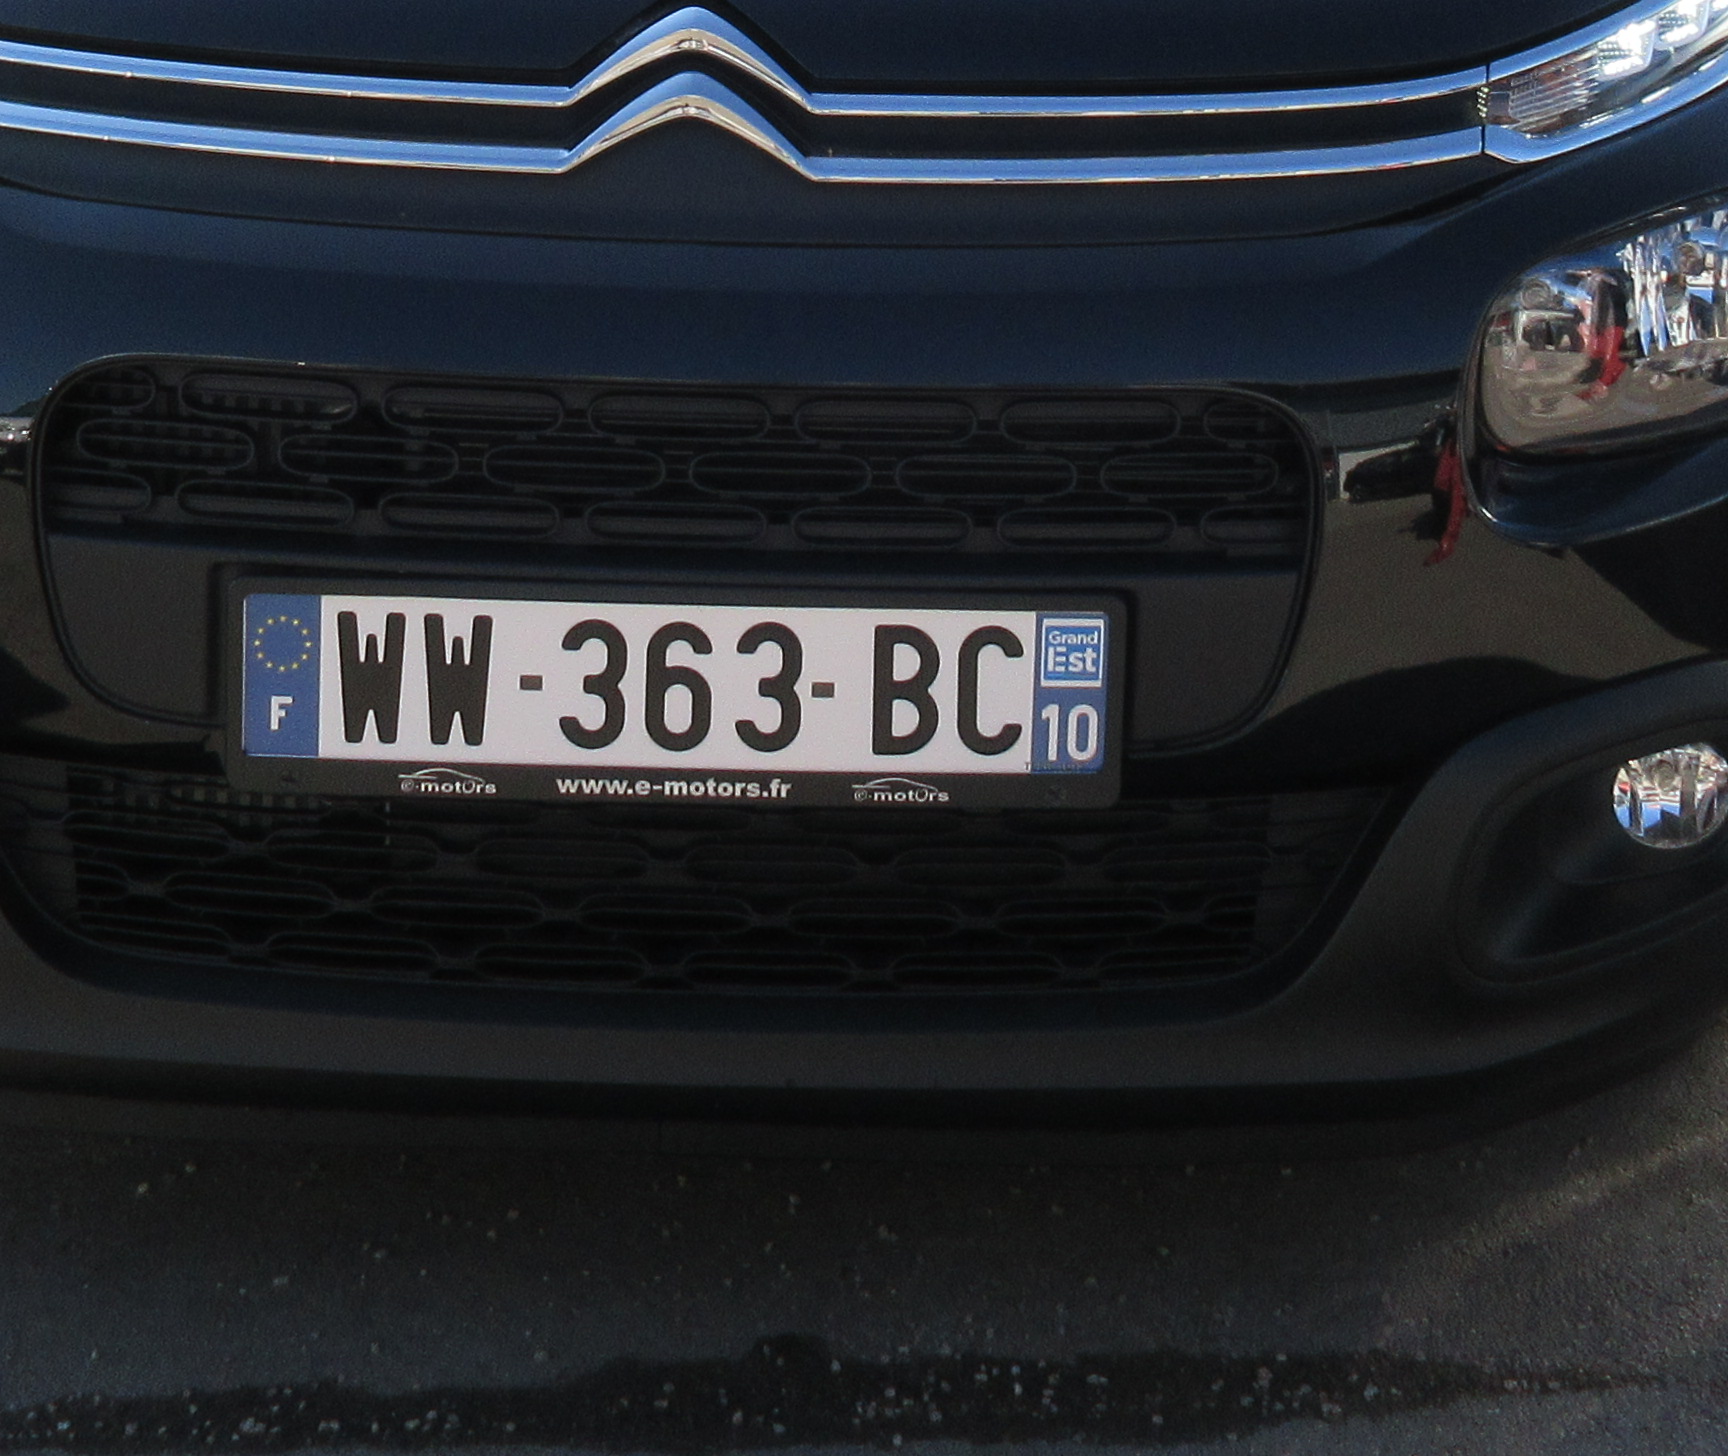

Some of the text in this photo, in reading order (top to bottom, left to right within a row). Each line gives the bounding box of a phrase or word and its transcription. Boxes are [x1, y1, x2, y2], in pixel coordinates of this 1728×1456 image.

[1048, 630, 1099, 645] Grand
[1046, 646, 1098, 673] Est
[269, 695, 294, 731] F
[1041, 704, 1099, 762] 10
[555, 776, 793, 799] www.e-motors.fr
